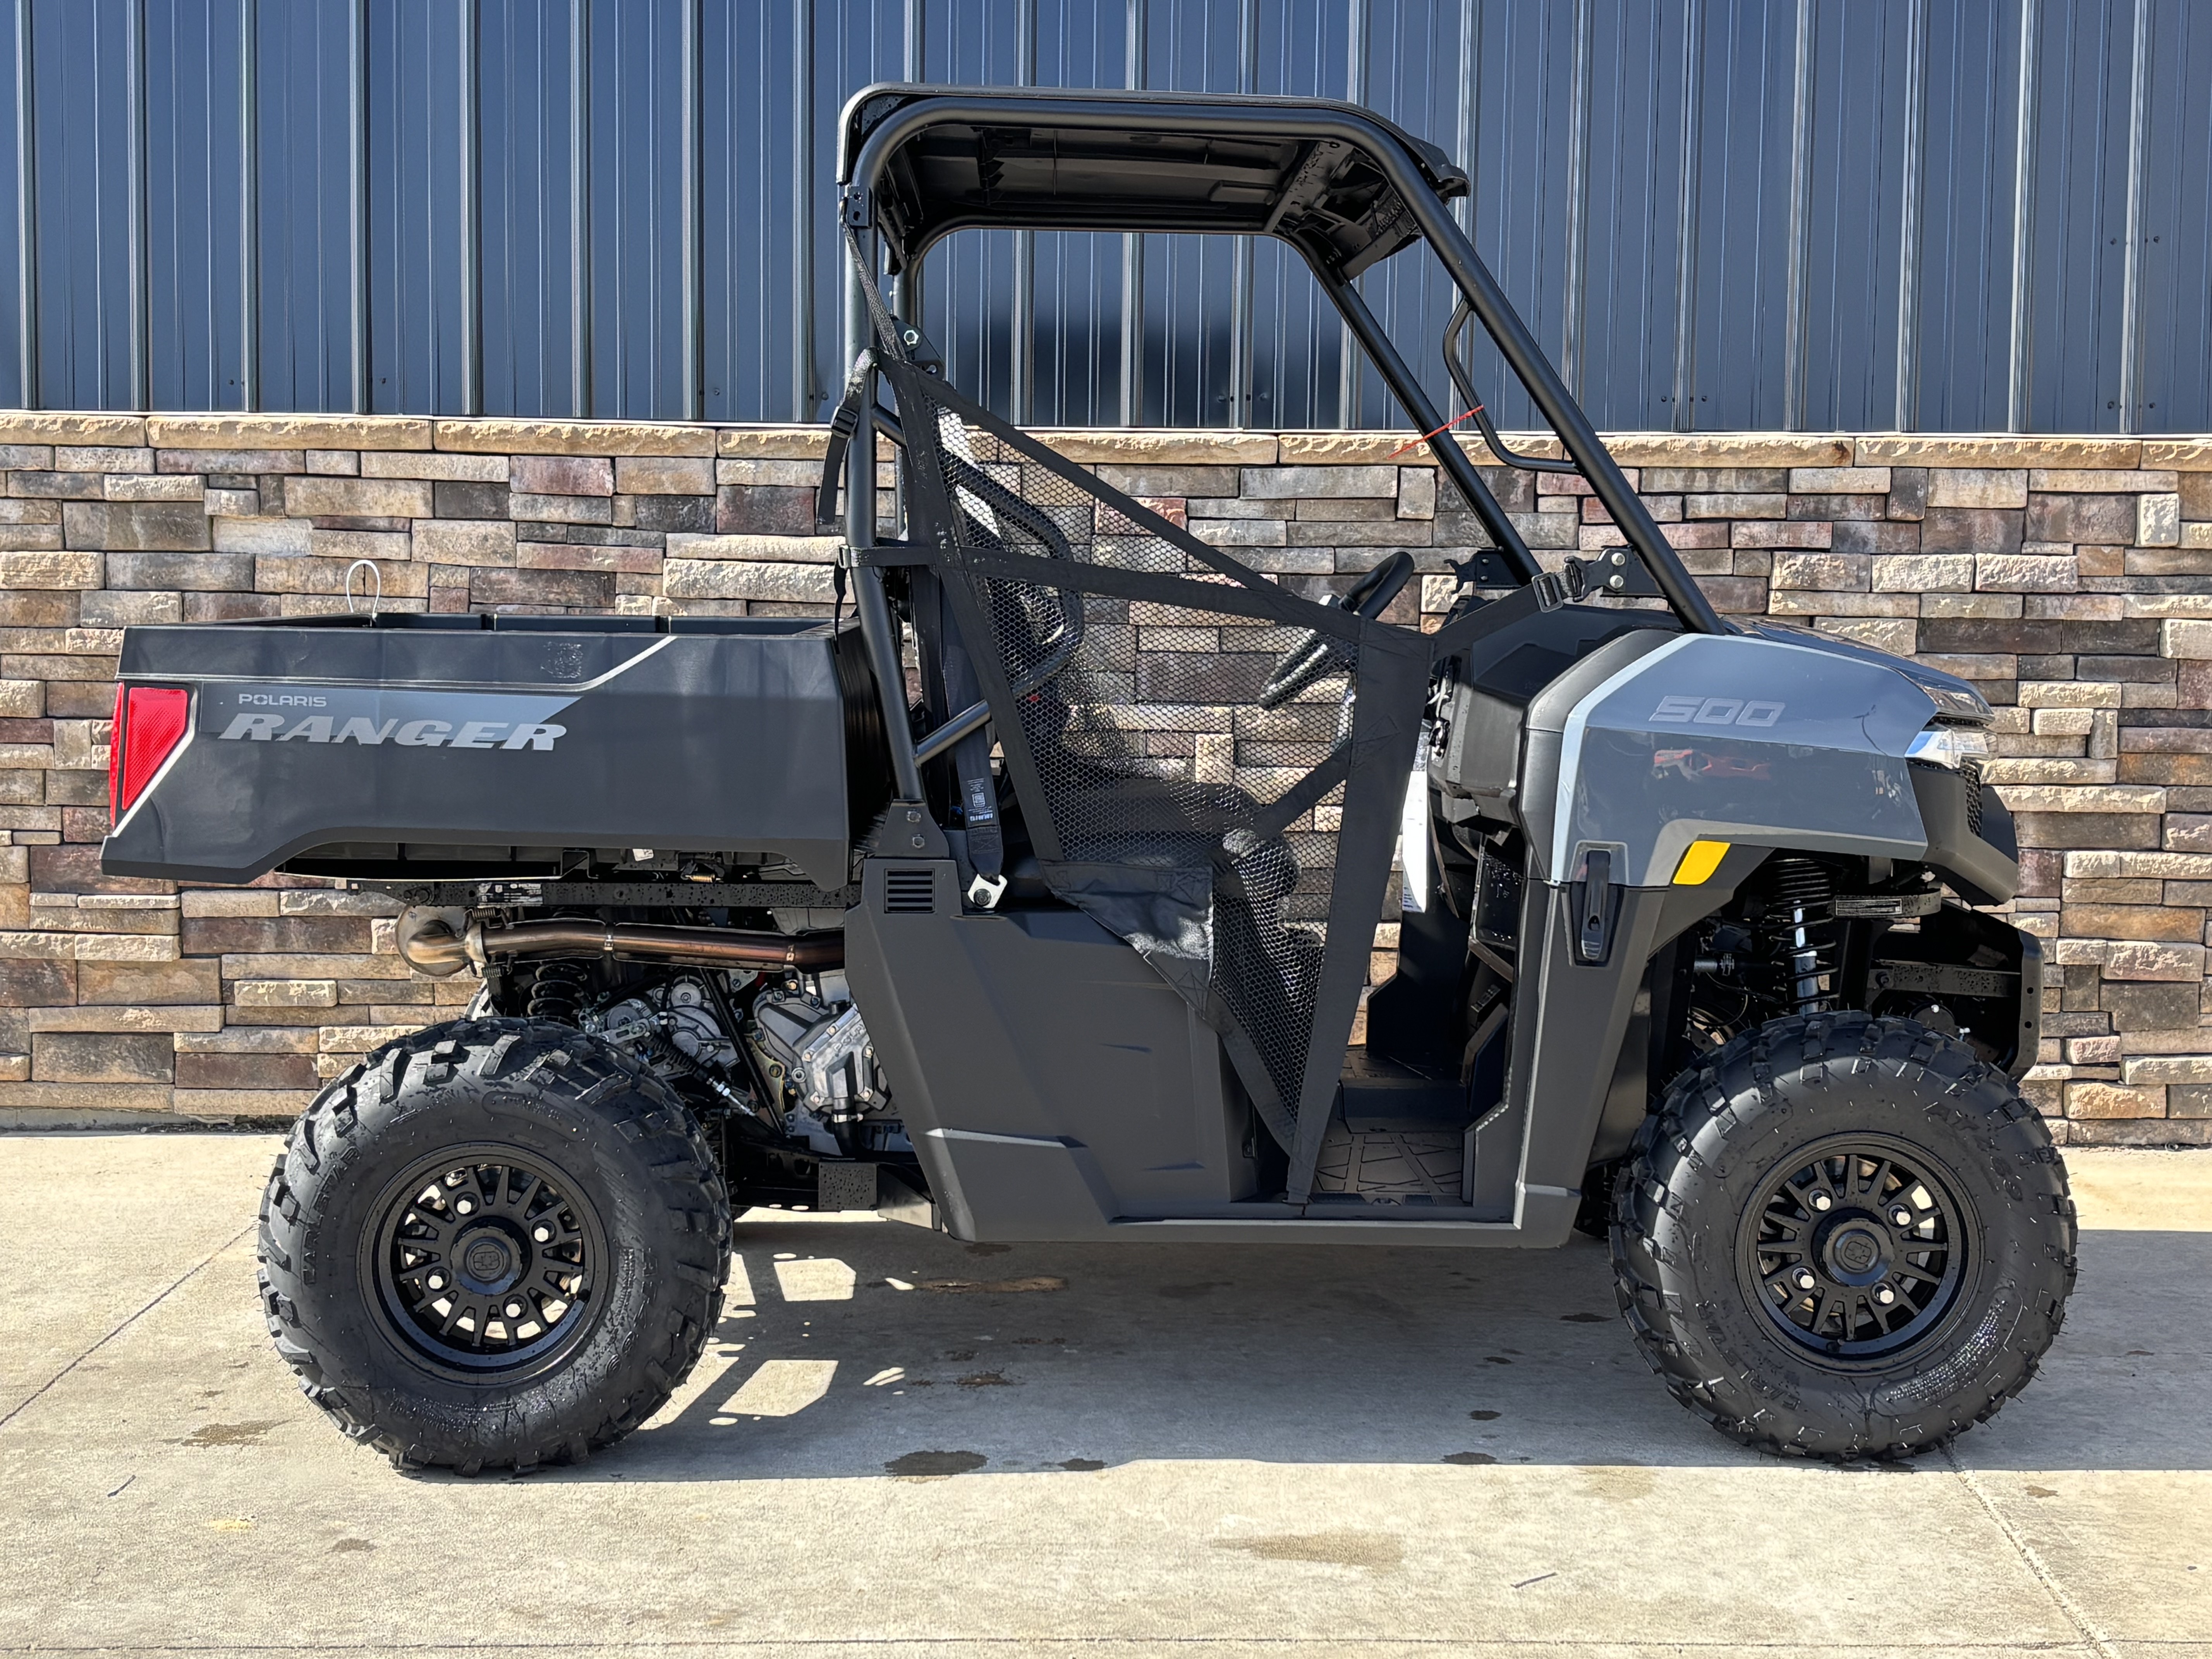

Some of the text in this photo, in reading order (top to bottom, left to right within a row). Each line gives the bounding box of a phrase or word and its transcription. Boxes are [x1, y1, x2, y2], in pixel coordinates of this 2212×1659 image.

[239, 693, 327, 708] POLARIS
[1649, 696, 1786, 727] 500
[219, 713, 567, 750] RANGER
[833, 1024, 865, 1053] POLA
